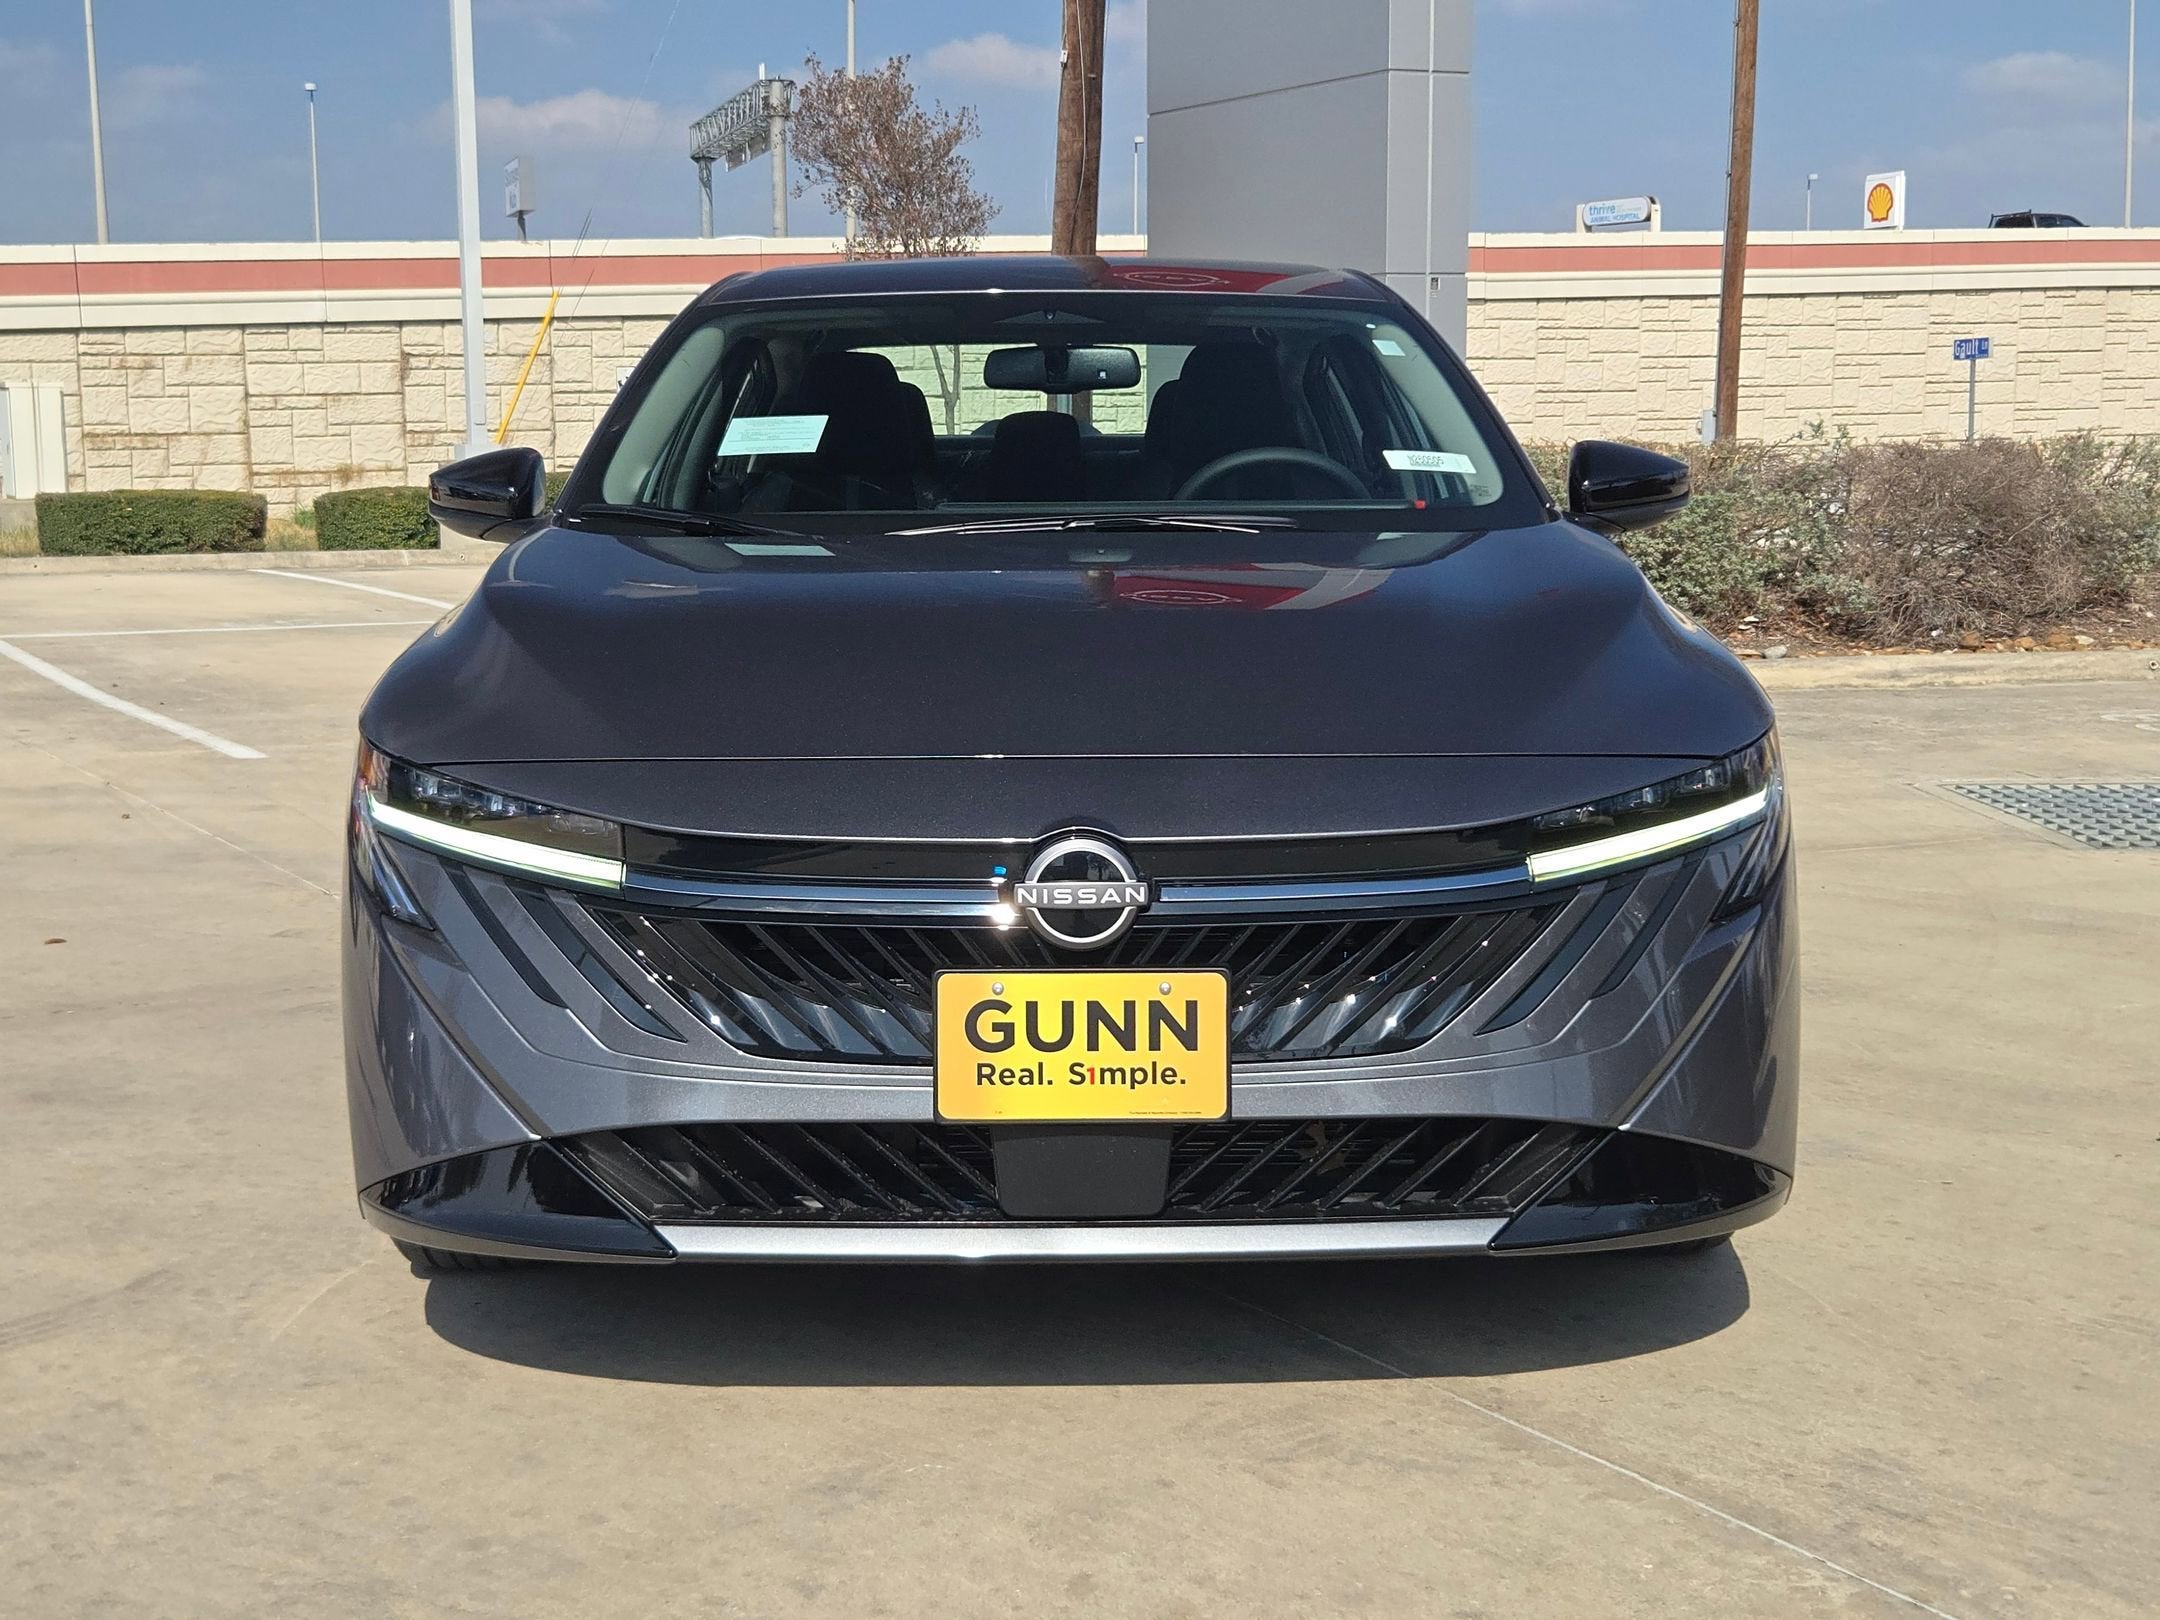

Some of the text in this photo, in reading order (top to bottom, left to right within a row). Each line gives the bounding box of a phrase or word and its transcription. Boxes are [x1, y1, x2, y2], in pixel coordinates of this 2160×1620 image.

[1589, 205, 1616, 216] thrive
[1612, 212, 1640, 221] HOSPITAL
[1955, 339, 1979, 356] Gault
[1017, 886, 1145, 904] NISSAN
[964, 998, 1198, 1053] GUNN
[976, 1061, 1053, 1085] Real.
